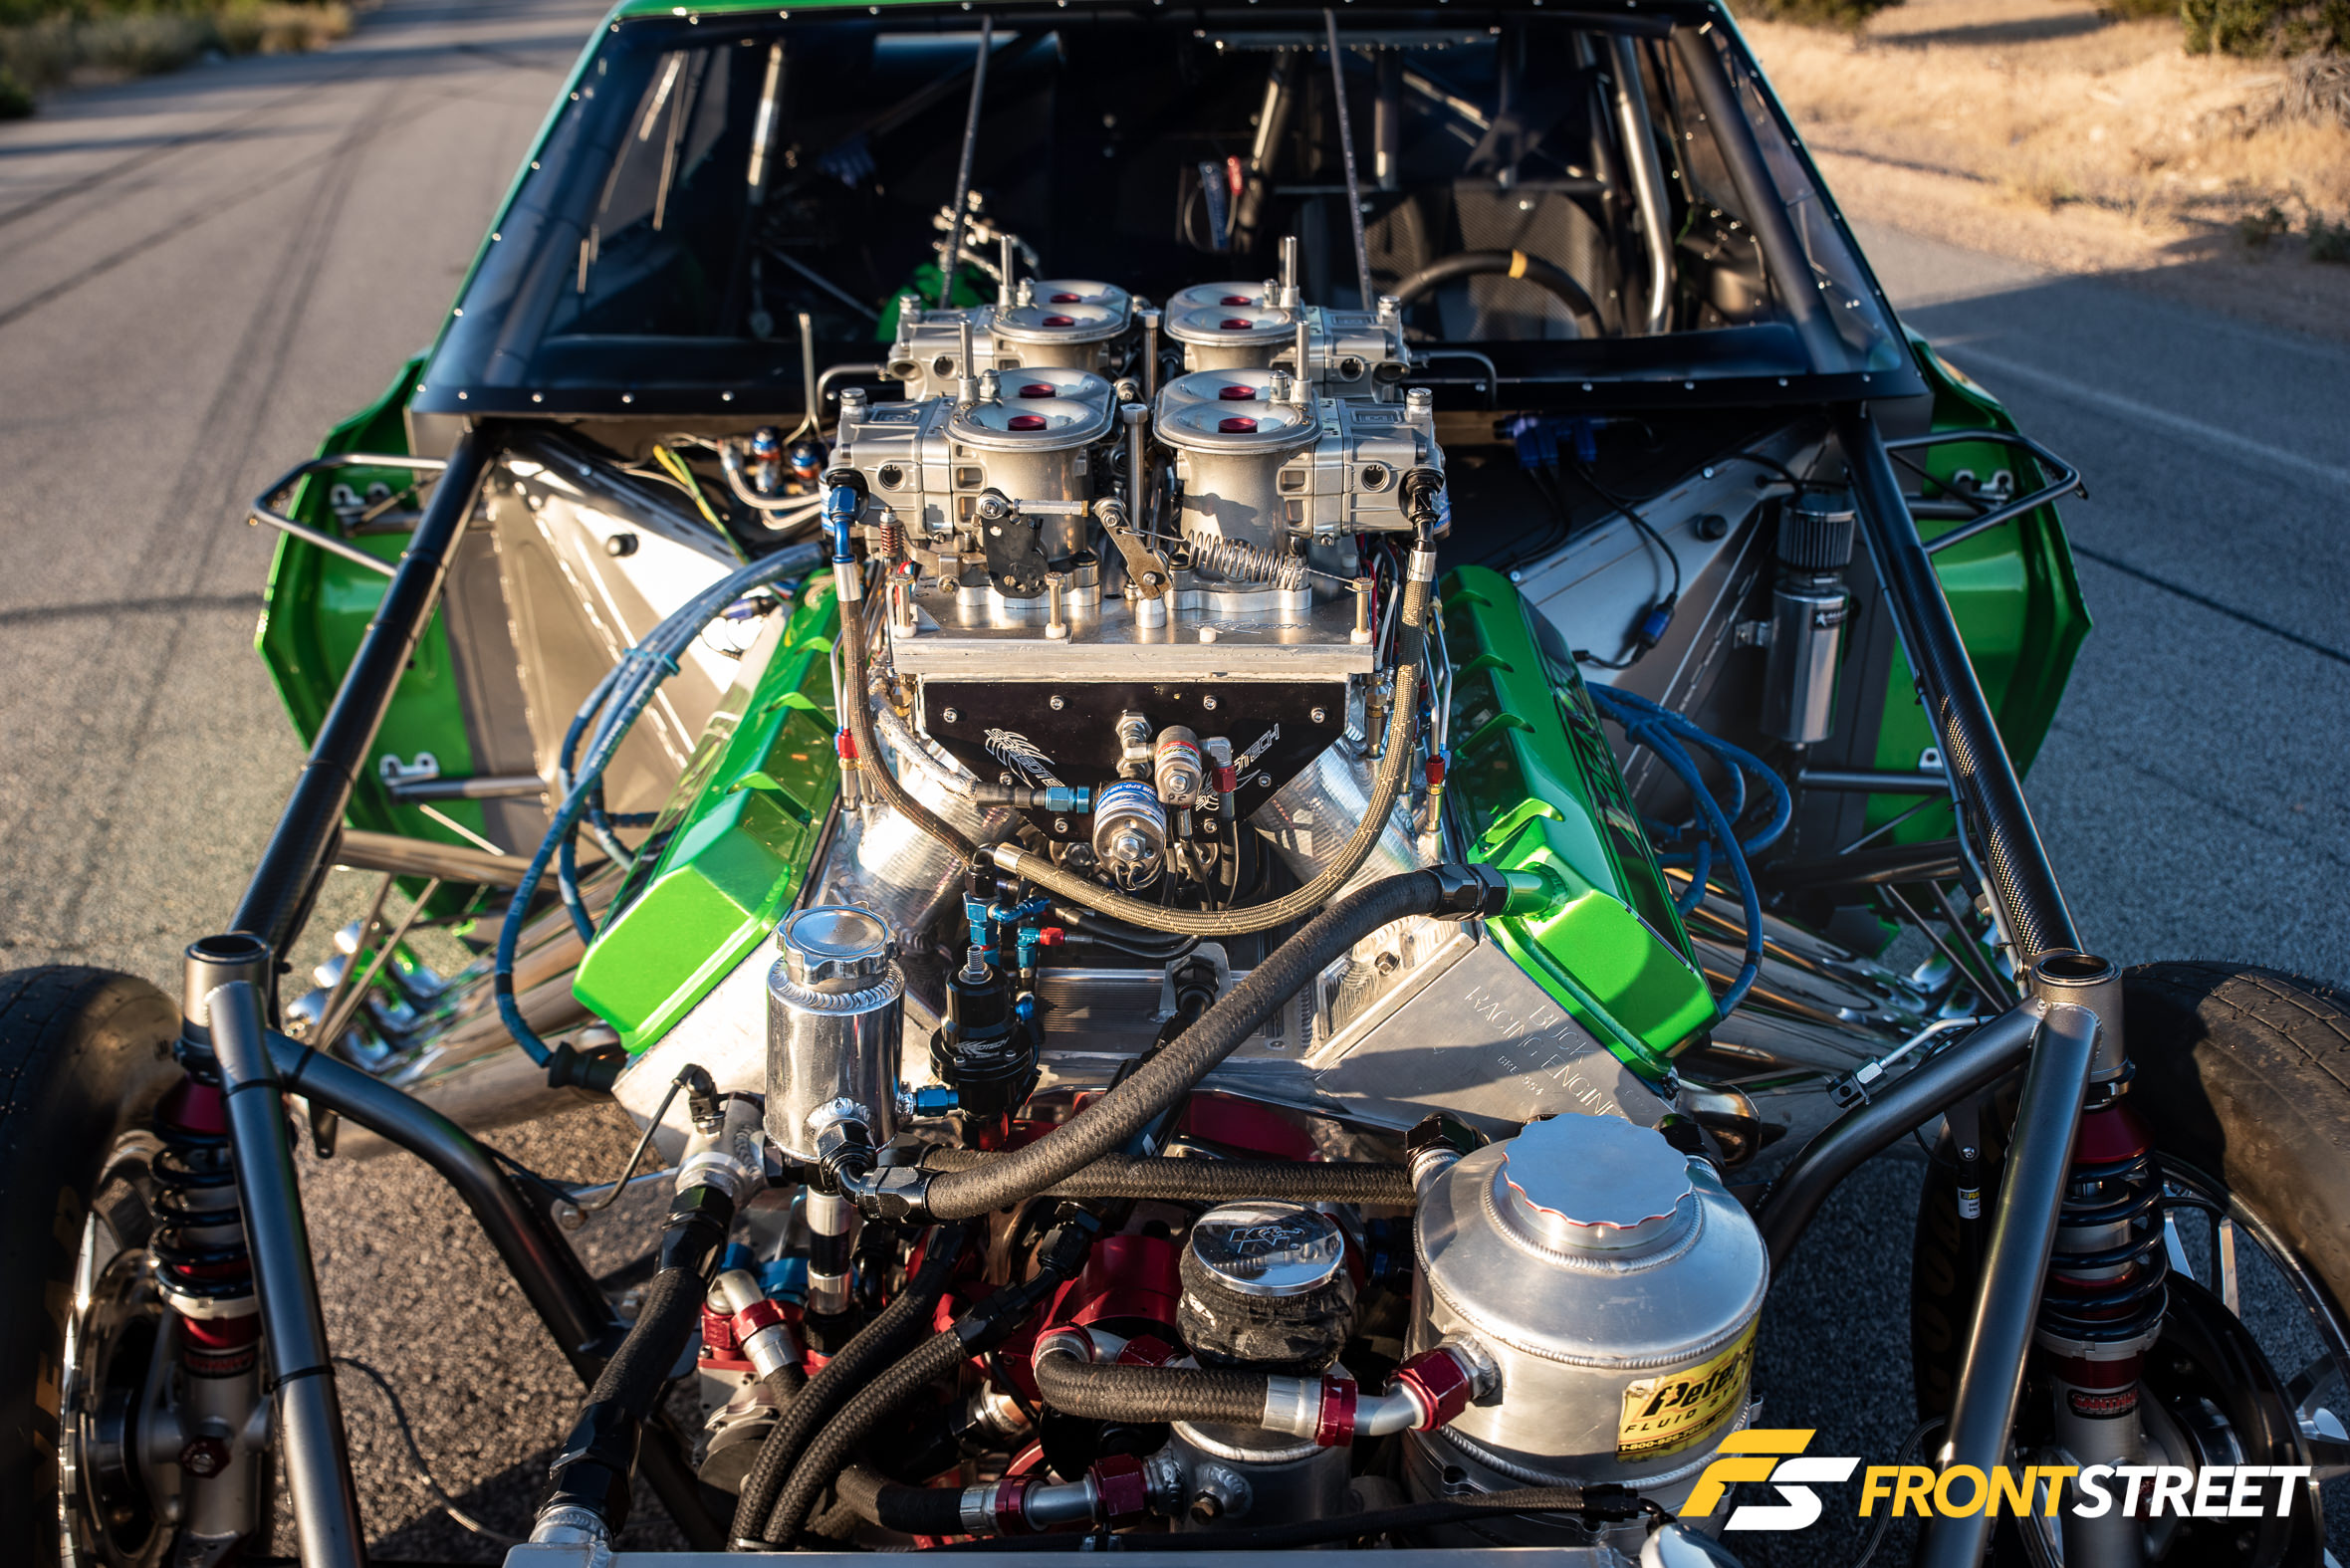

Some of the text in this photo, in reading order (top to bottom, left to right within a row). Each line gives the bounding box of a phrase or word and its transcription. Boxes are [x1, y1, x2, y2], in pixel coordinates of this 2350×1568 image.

[1465, 986, 1544, 1058] RACING
[1528, 1005, 1594, 1065] BUCK
[1624, 1408, 1697, 1434] FLUID
